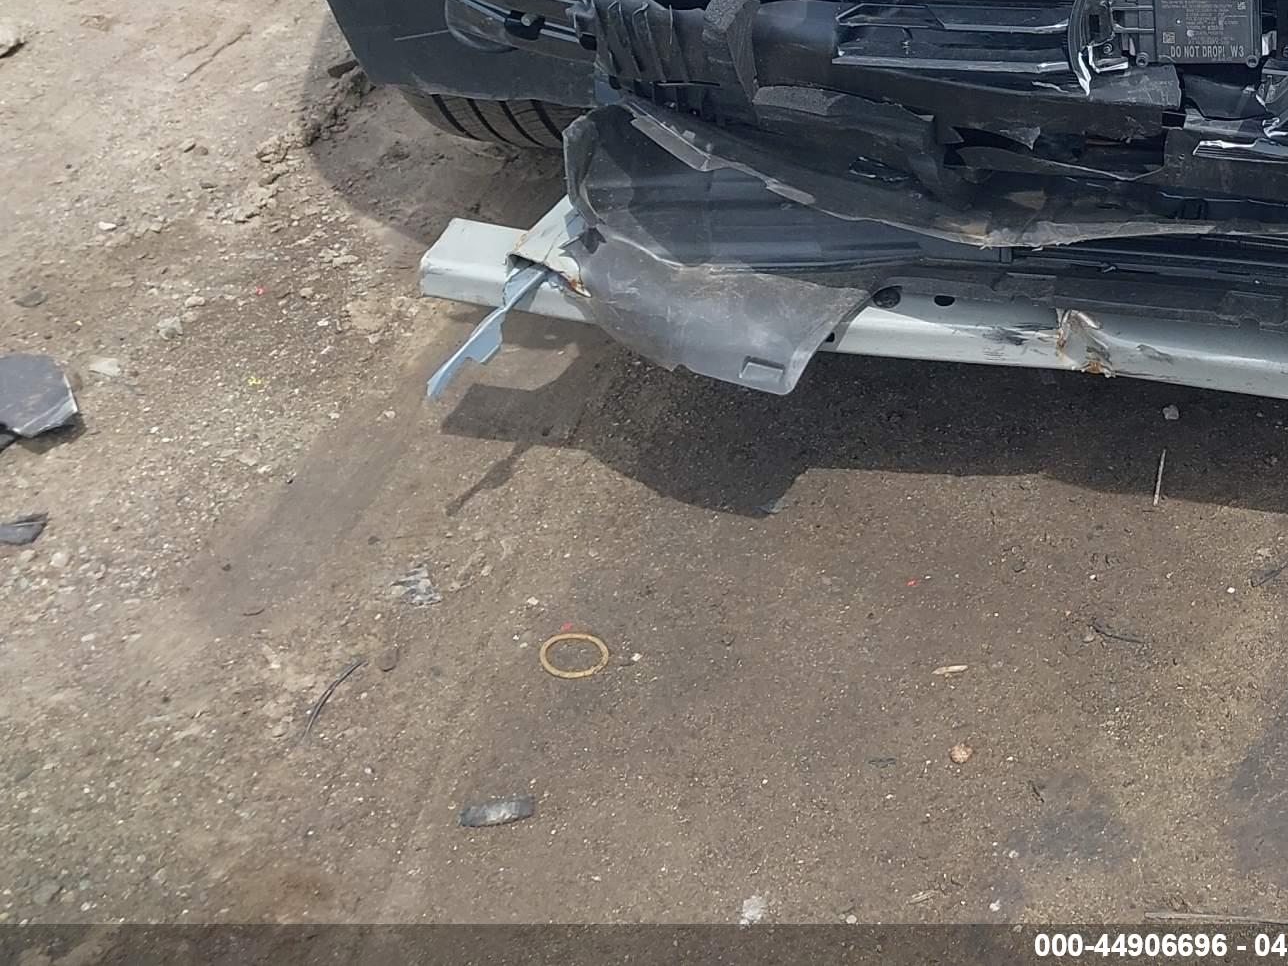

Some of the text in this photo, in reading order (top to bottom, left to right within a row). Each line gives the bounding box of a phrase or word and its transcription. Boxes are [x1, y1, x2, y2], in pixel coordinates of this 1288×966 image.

[1170, 45, 1245, 58] DO NOT DROP! W3
